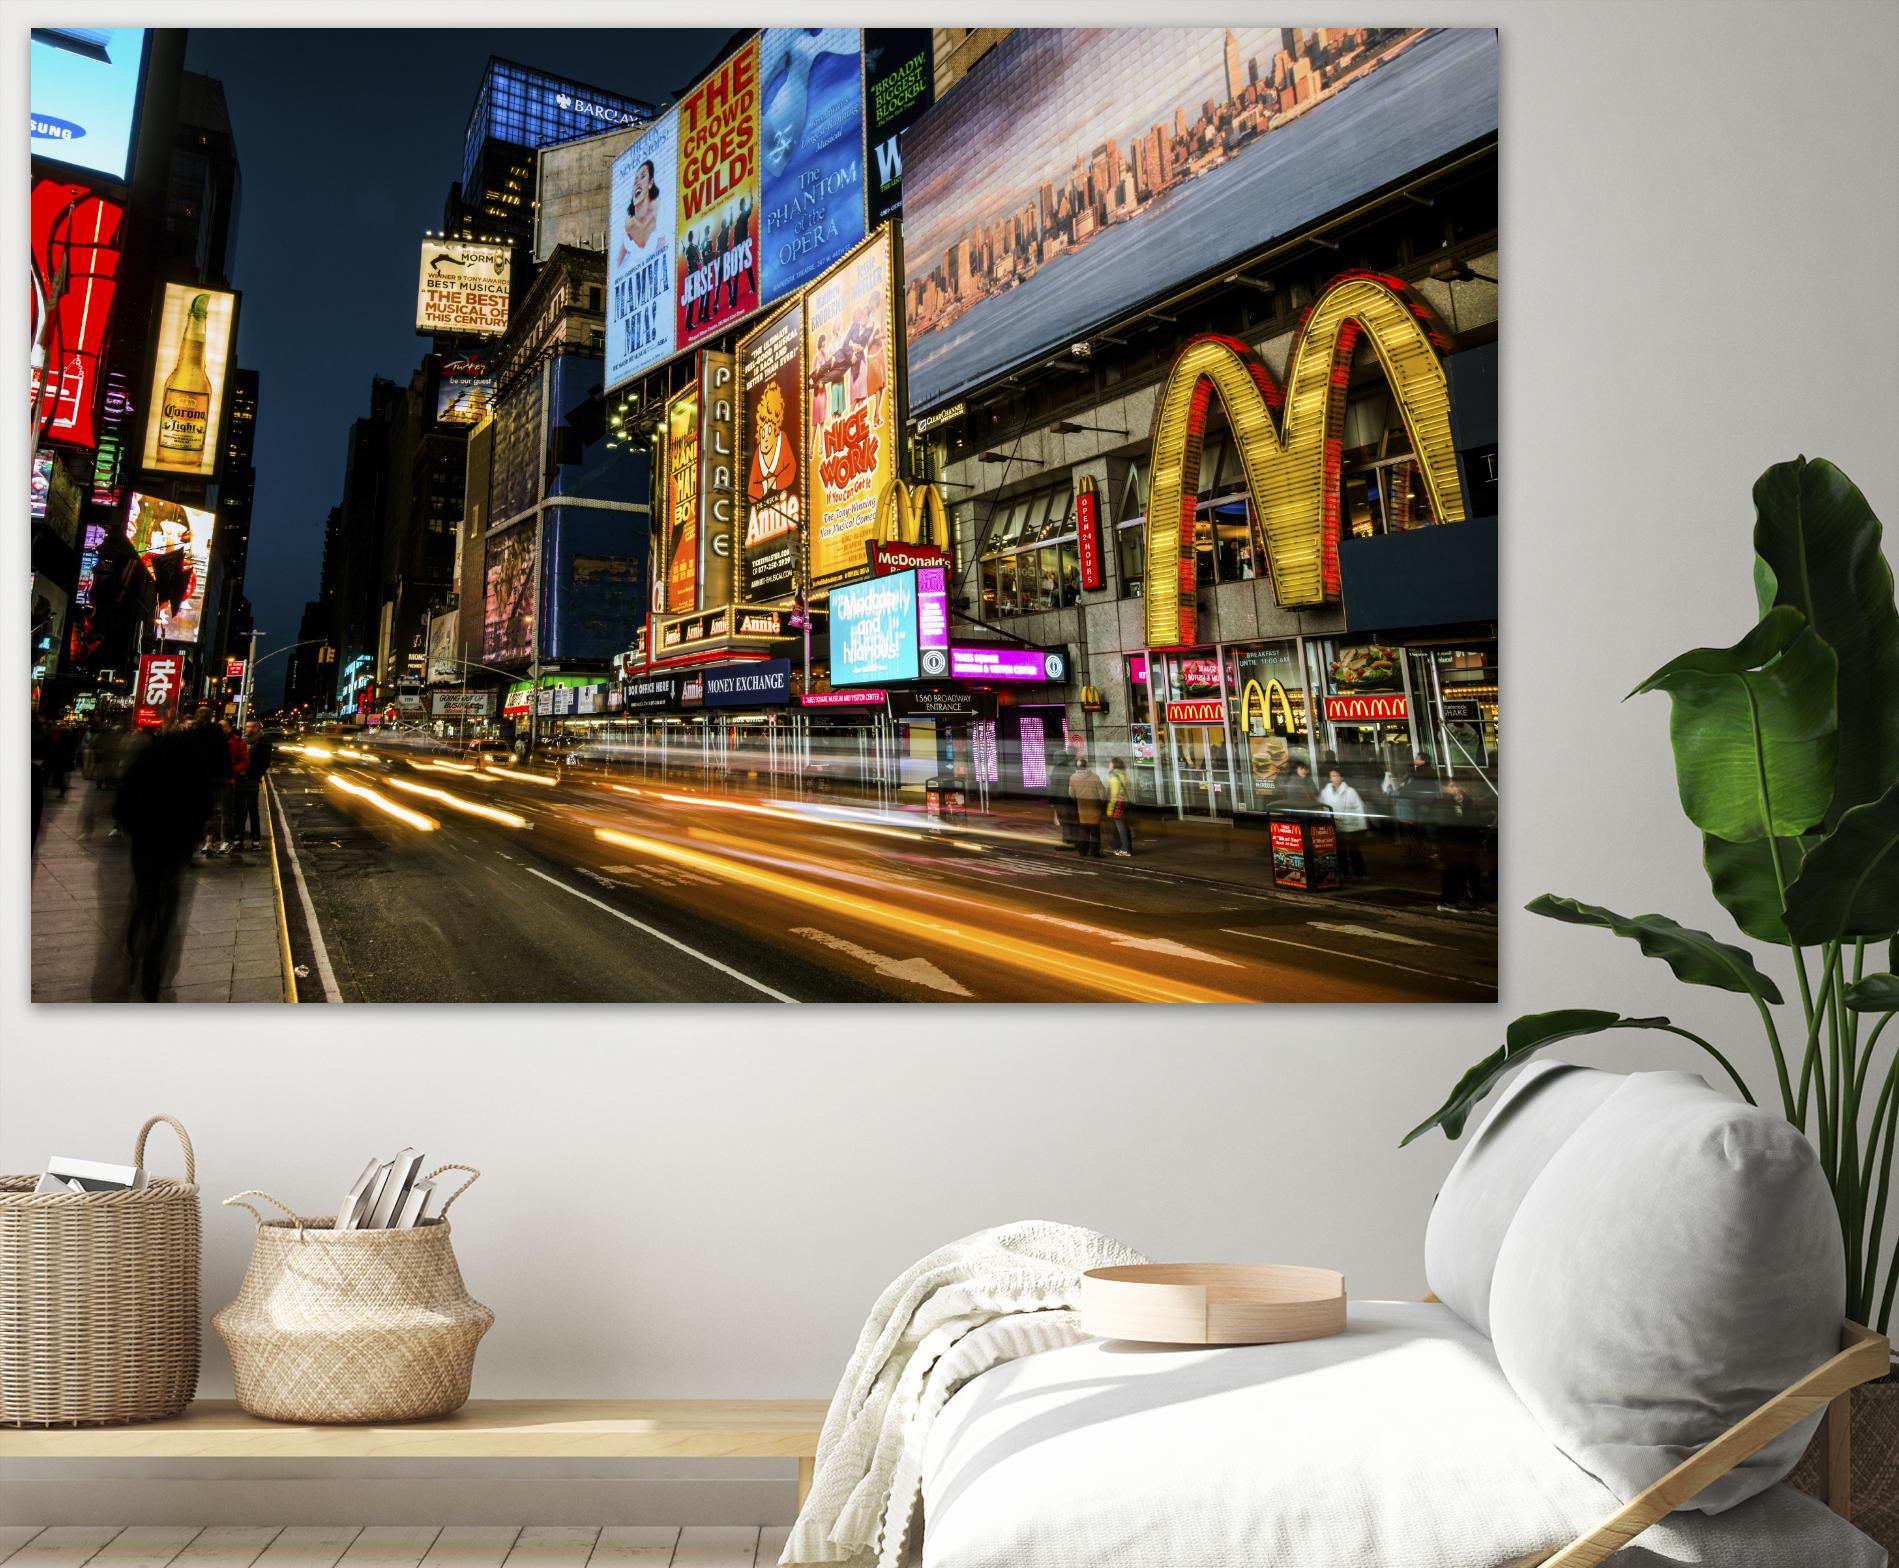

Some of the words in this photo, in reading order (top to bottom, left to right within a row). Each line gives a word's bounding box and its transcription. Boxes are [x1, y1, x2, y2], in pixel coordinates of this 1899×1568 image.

[684, 45, 753, 133] THE
[876, 66, 923, 108] BIGGEST
[684, 90, 753, 159] CROWD
[683, 114, 753, 189] GOES
[798, 168, 820, 189] The
[767, 160, 856, 233] PHANTOM
[795, 213, 806, 234] of
[808, 207, 825, 227] the
[779, 218, 839, 265] OPERA
[680, 256, 720, 307] JERSEY
[723, 237, 753, 282] BOYS
[427, 280, 456, 289] BEST
[460, 282, 509, 294] MUSICAL
[614, 254, 669, 323] MAMMA
[425, 302, 486, 317] MUSICAL
[490, 308, 508, 318] OF
[466, 293, 509, 307] BEST
[425, 312, 451, 322] THIS
[454, 316, 507, 327] CENTURY
[624, 300, 657, 357] MIA!
[763, 326, 788, 350] ULTIMATE
[745, 348, 773, 374] FEEL-GOOD
[773, 328, 798, 352] MUSICAL
[754, 366, 760, 376] IS
[760, 355, 774, 371] BACK
[775, 346, 787, 361] AND
[450, 376, 458, 384] be
[474, 378, 491, 386] guest
[746, 372, 763, 391] BETTER
[764, 361, 779, 377] THAN
[164, 404, 206, 419] Corona
[170, 420, 196, 433] Light
[824, 405, 870, 459] NICE
[712, 366, 731, 557] PALACE
[819, 436, 878, 489] WORK
[826, 491, 831, 505] If
[832, 491, 842, 503] You
[843, 488, 854, 502] Can
[855, 479, 864, 492] Get
[866, 478, 872, 490] It
[745, 490, 799, 546] Annie
[819, 528, 832, 540] New
[832, 517, 855, 535] Musical
[824, 513, 834, 524] The
[1082, 533, 1092, 541] 24
[878, 552, 951, 569] McDonald's
[1084, 543, 1093, 583] HOURS
[686, 624, 704, 640] Annie
[710, 618, 730, 635] Annie
[740, 614, 780, 634] Annie
[665, 628, 680, 644] Annie
[1240, 659, 1257, 667] UNTIL
[1247, 650, 1279, 658] BREAKFAST
[146, 659, 176, 705] tkts
[628, 685, 638, 696] BOX
[639, 683, 655, 695] OFFICE
[655, 680, 670, 692] HERE
[682, 680, 703, 700] Annie
[707, 679, 734, 693] MONEY
[735, 673, 784, 691] EXCHANGE
[851, 693, 865, 701] VISITOR
[916, 694, 932, 702] 1560
[933, 694, 971, 702] BROADWAY
[926, 703, 961, 711] ENTRANCE
